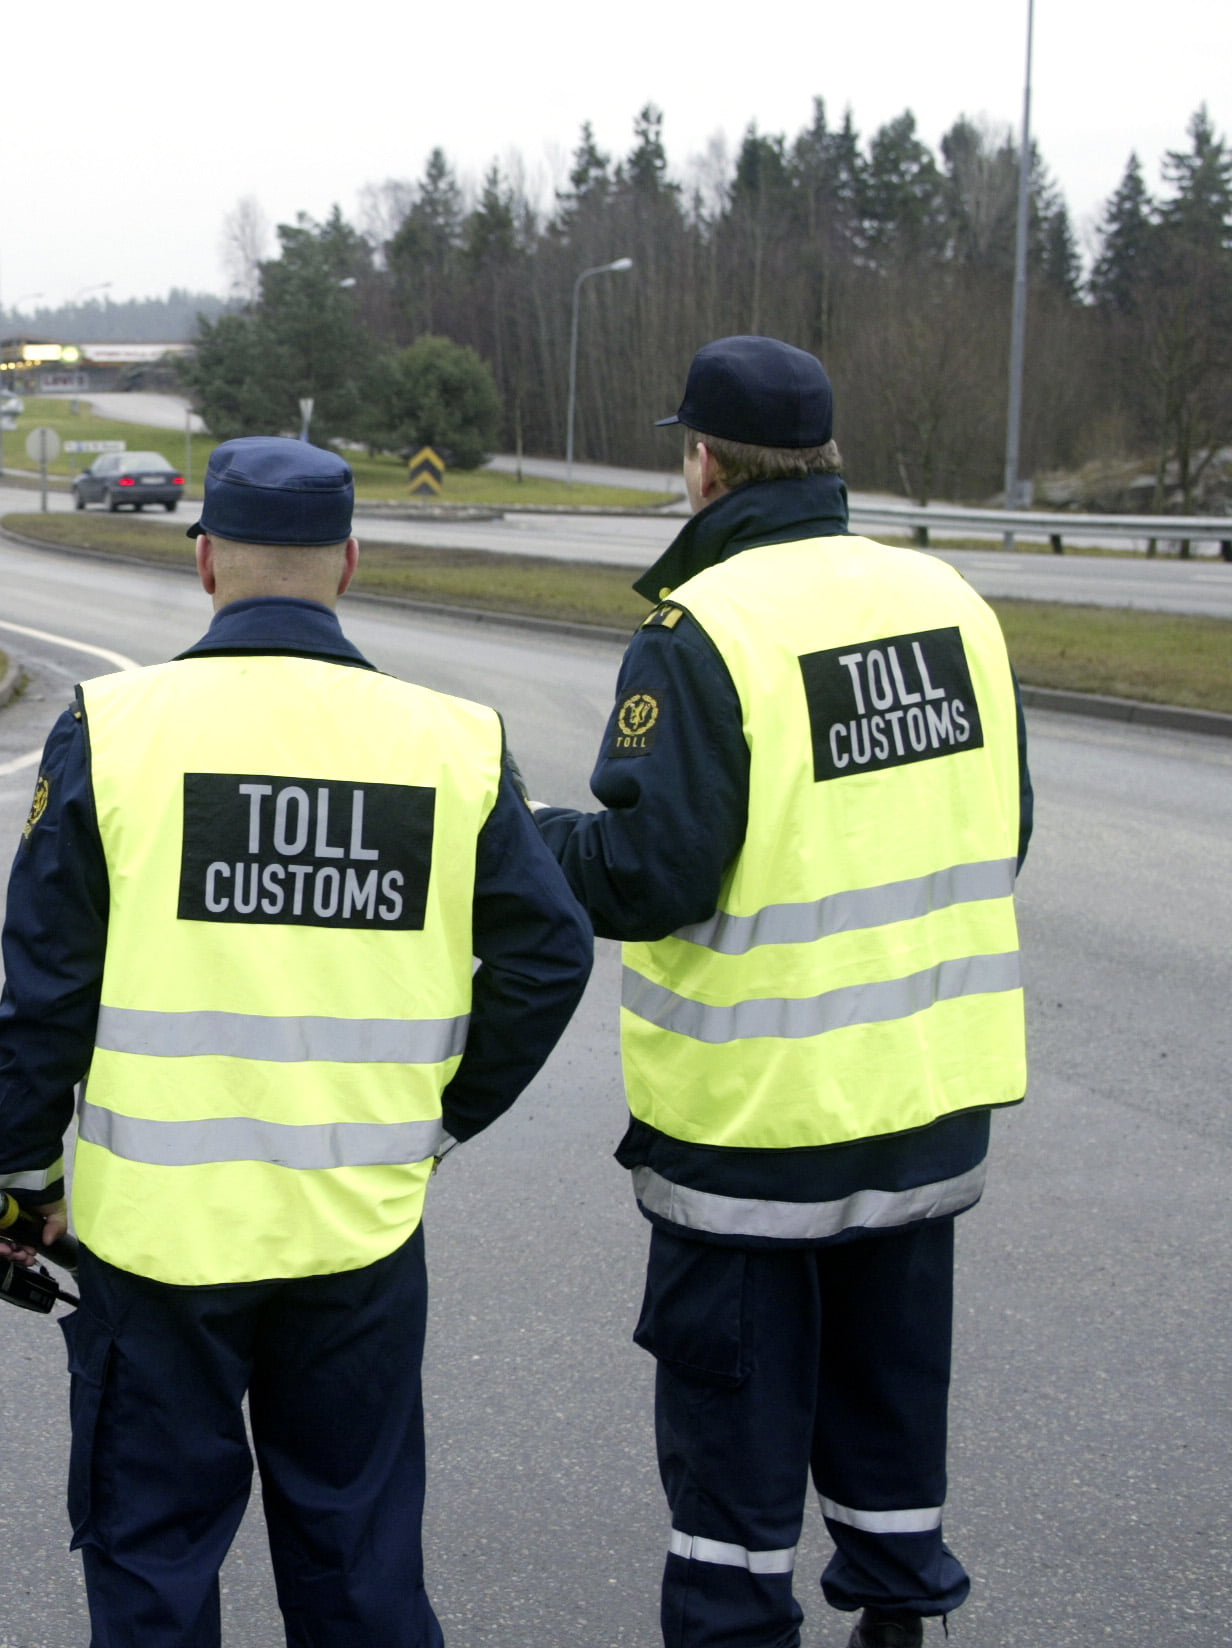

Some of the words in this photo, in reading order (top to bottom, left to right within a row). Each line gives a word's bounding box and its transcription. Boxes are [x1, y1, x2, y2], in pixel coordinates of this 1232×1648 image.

[838, 641, 946, 715] TOLL
[616, 736, 646, 748] TOLL
[829, 699, 970, 769] CUSTOMS
[239, 783, 379, 860] TOLL
[205, 861, 404, 921] CUSTOMS
